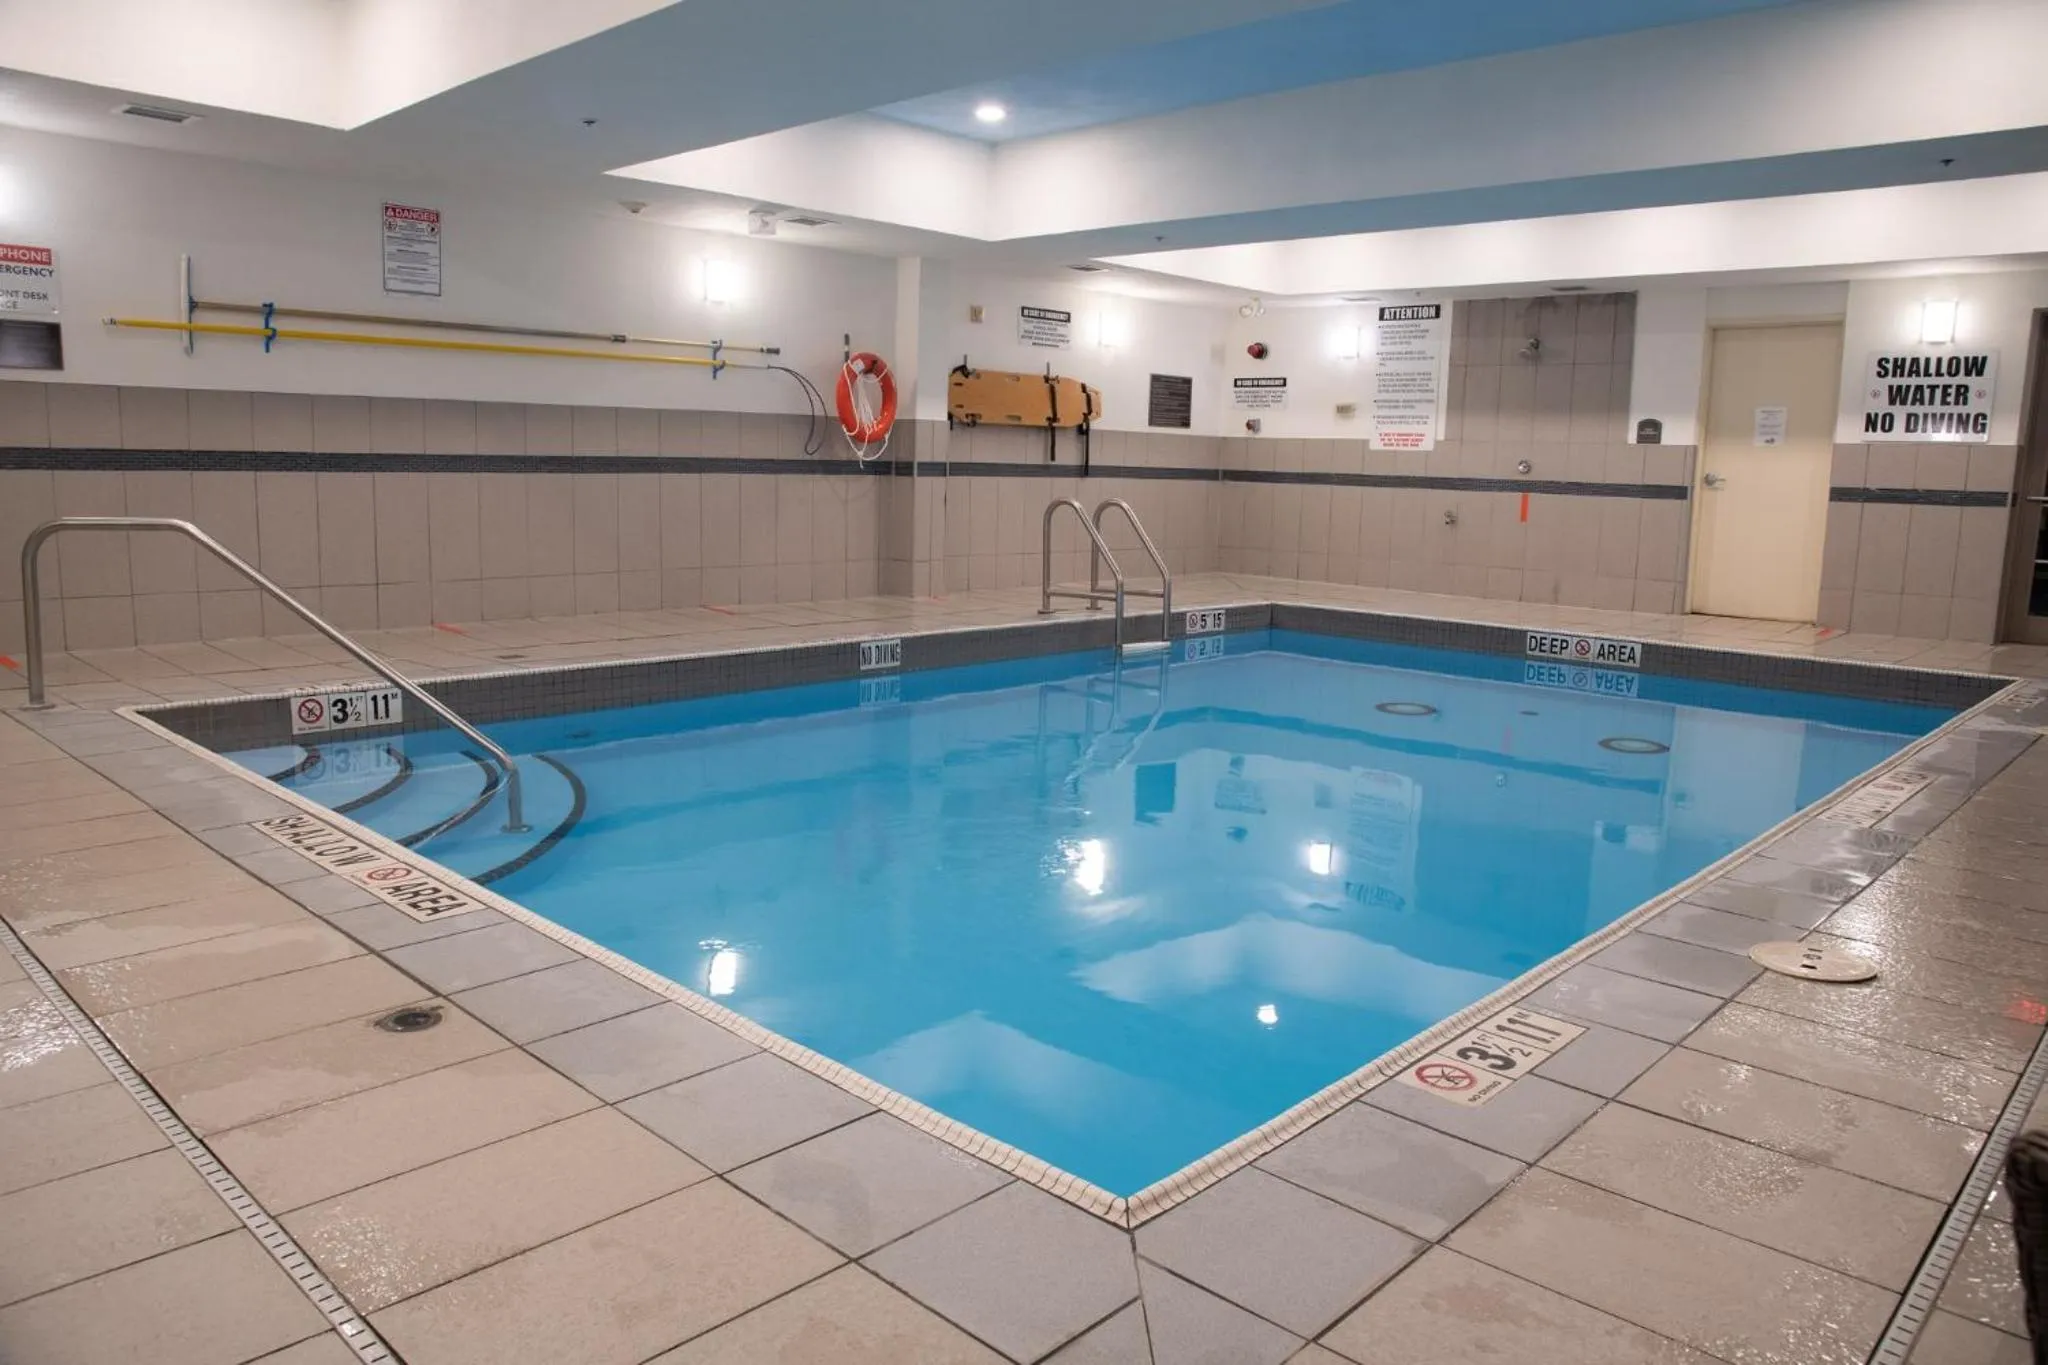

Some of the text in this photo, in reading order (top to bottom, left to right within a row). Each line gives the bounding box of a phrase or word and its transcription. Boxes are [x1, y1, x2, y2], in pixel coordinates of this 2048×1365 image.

[395, 207, 438, 222] DANGER
[23, 291, 49, 301] DESK
[1383, 306, 1436, 320] ATTENTION
[1876, 355, 1988, 379] SHALLOW
[1887, 384, 1970, 406] WATER
[1864, 411, 1989, 435] NO DIVING
[1199, 613, 1207, 630] 5
[861, 642, 900, 667] NO DIVING
[1528, 634, 1637, 664] DEEP AREA
[262, 816, 469, 917] SHALLOW AREA
[1467, 1080, 1502, 1102] NO DIVING
